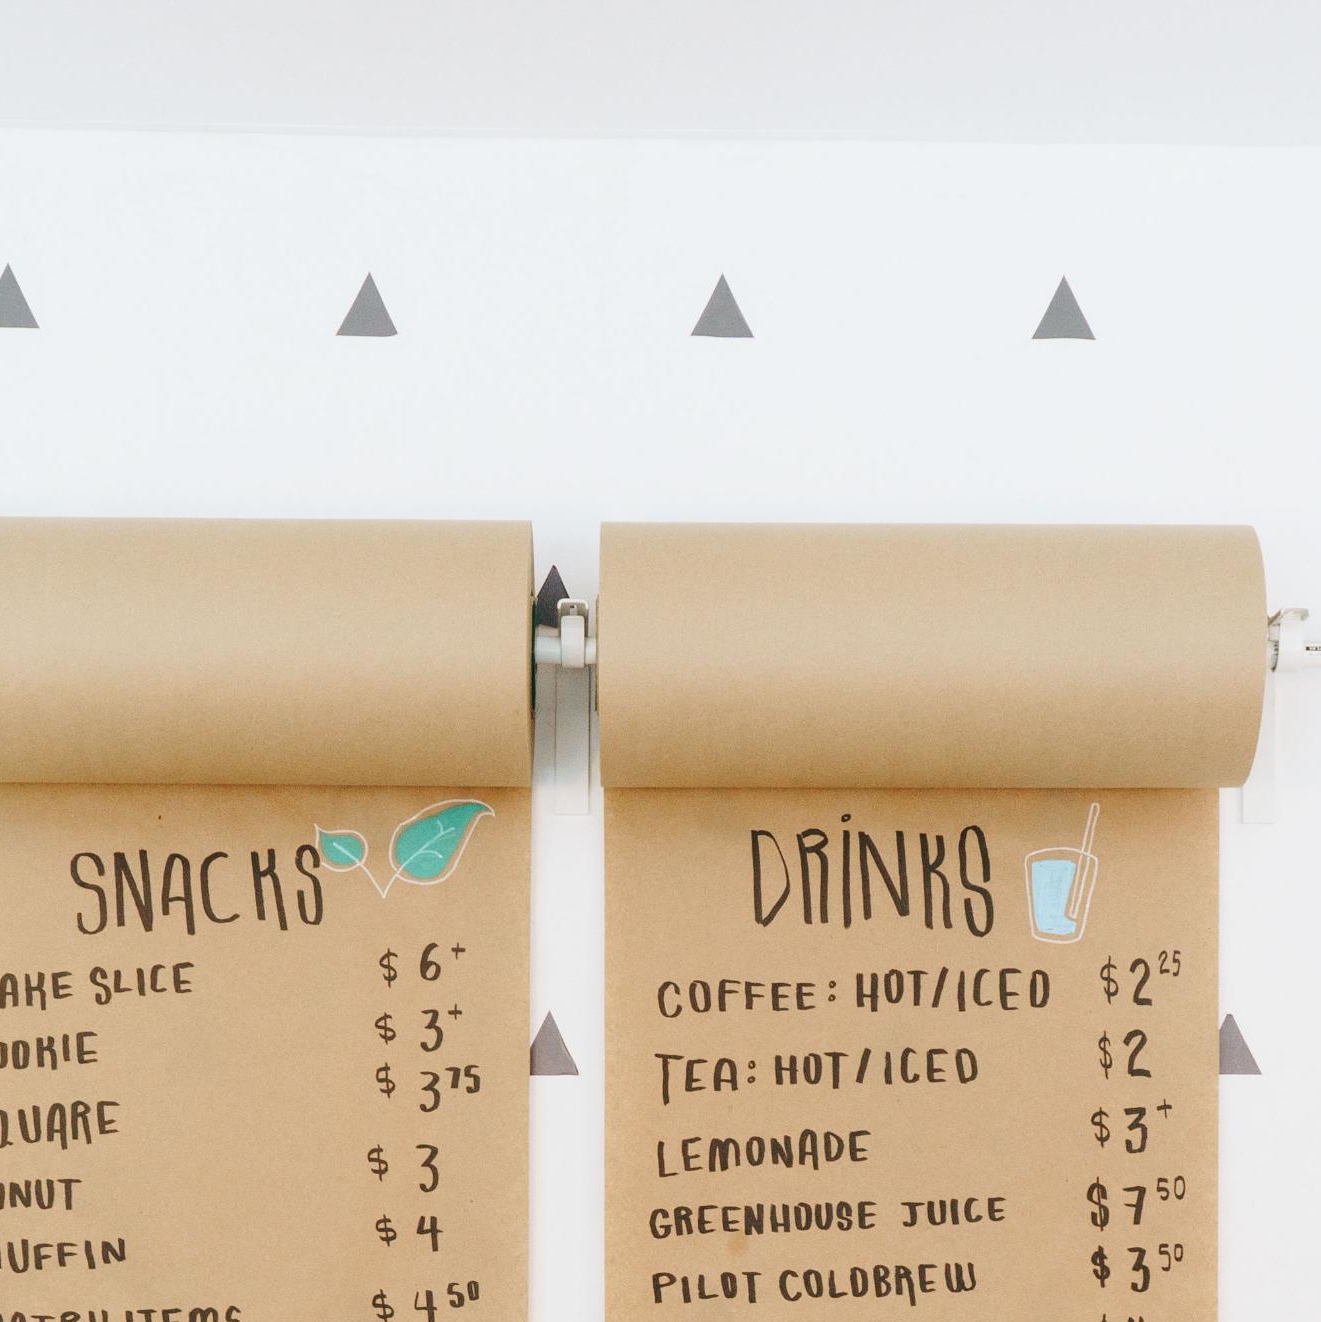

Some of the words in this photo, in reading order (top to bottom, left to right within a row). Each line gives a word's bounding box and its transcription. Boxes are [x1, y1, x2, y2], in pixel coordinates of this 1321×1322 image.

[70, 843, 324, 936] SNACKS
[89, 961, 195, 1006] SLICE
[657, 978, 837, 1019] COFFEE:
[855, 966, 1051, 1013] HOT/ICED
[654, 1053, 757, 1107] TEA:
[774, 1046, 979, 1090] HOT/ICED
[656, 1128, 871, 1178] LEMONADE
[648, 1200, 877, 1240] GREENHOUSE
[900, 1196, 1007, 1228] JUICE
[651, 1271, 762, 1305] PILOT
[778, 1261, 977, 1307] COLDBREW
